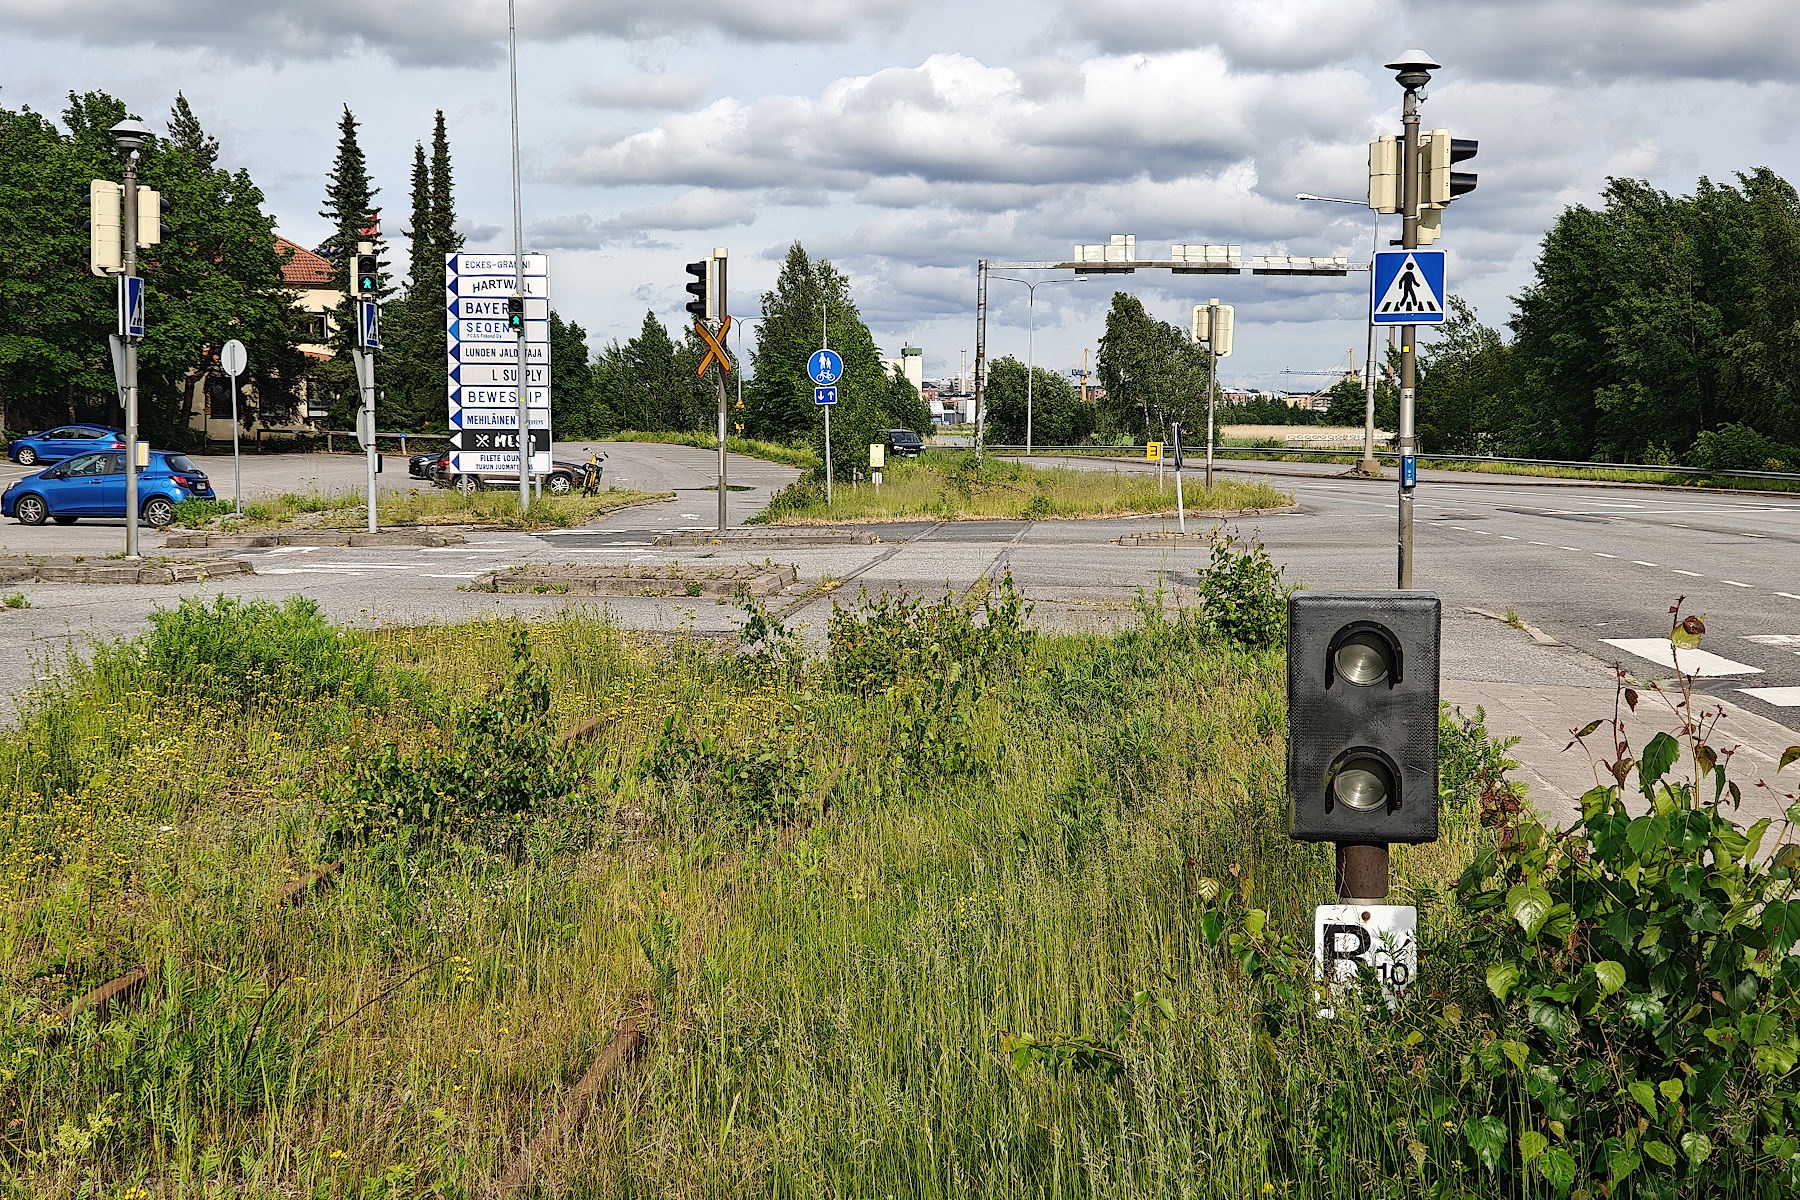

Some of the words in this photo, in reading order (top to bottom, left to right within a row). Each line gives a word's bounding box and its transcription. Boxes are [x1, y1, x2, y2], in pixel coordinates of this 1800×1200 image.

[465, 260, 530, 269] ECKES-GRANI
[472, 279, 533, 294] HARTWL
[465, 302, 510, 315] BAYER
[466, 322, 518, 333] SEQEN
[465, 348, 496, 357] LUNDEN
[499, 348, 542, 358] JALOTAJA
[492, 369, 498, 381] L
[503, 369, 542, 382] SUPLY
[468, 391, 542, 403] BEWESIP
[466, 412, 516, 425] MEHILÄINEN
[1323, 924, 1371, 977] R
[1377, 962, 1409, 986] 10
